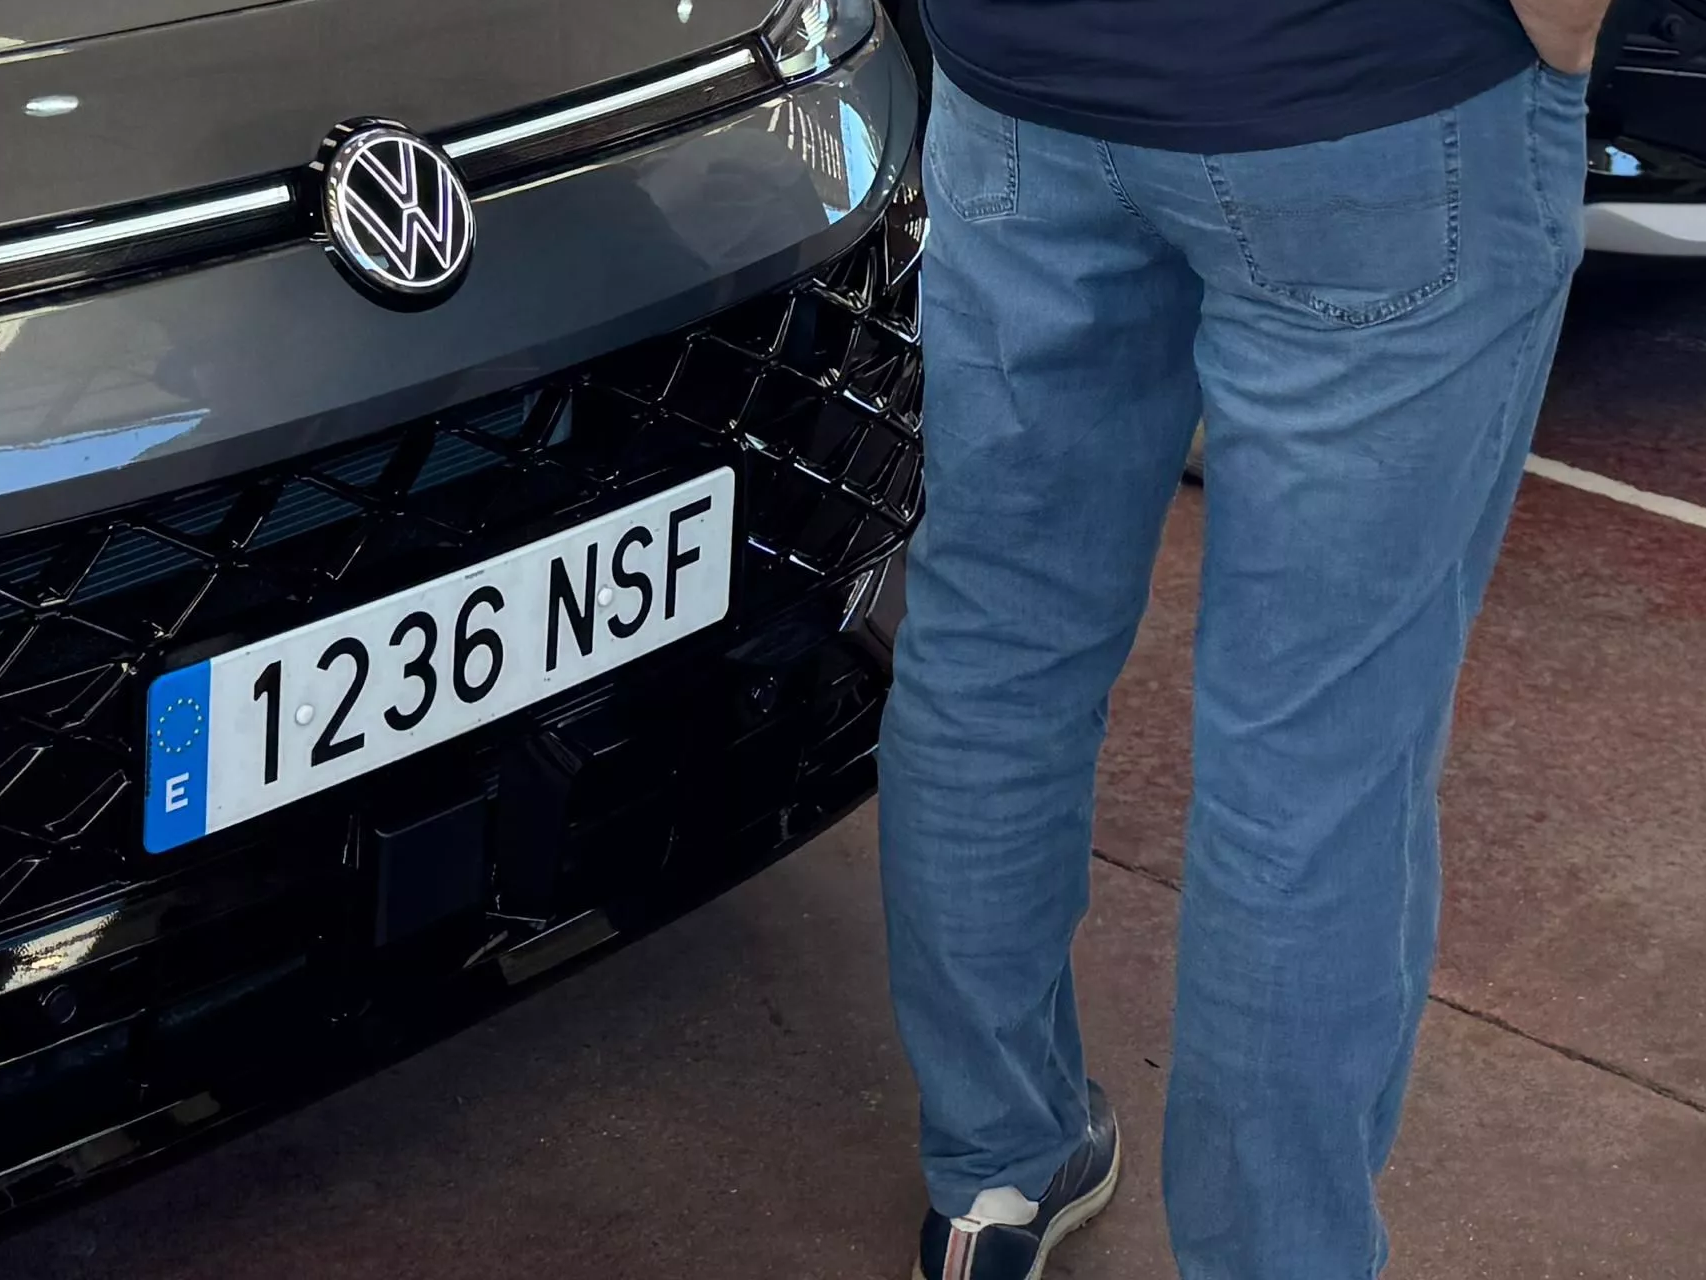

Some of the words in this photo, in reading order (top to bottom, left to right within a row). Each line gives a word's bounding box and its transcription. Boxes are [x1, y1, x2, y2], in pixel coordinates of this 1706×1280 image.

[253, 585, 506, 786] 1236
[544, 494, 713, 673] NSF
[164, 772, 190, 814] E
